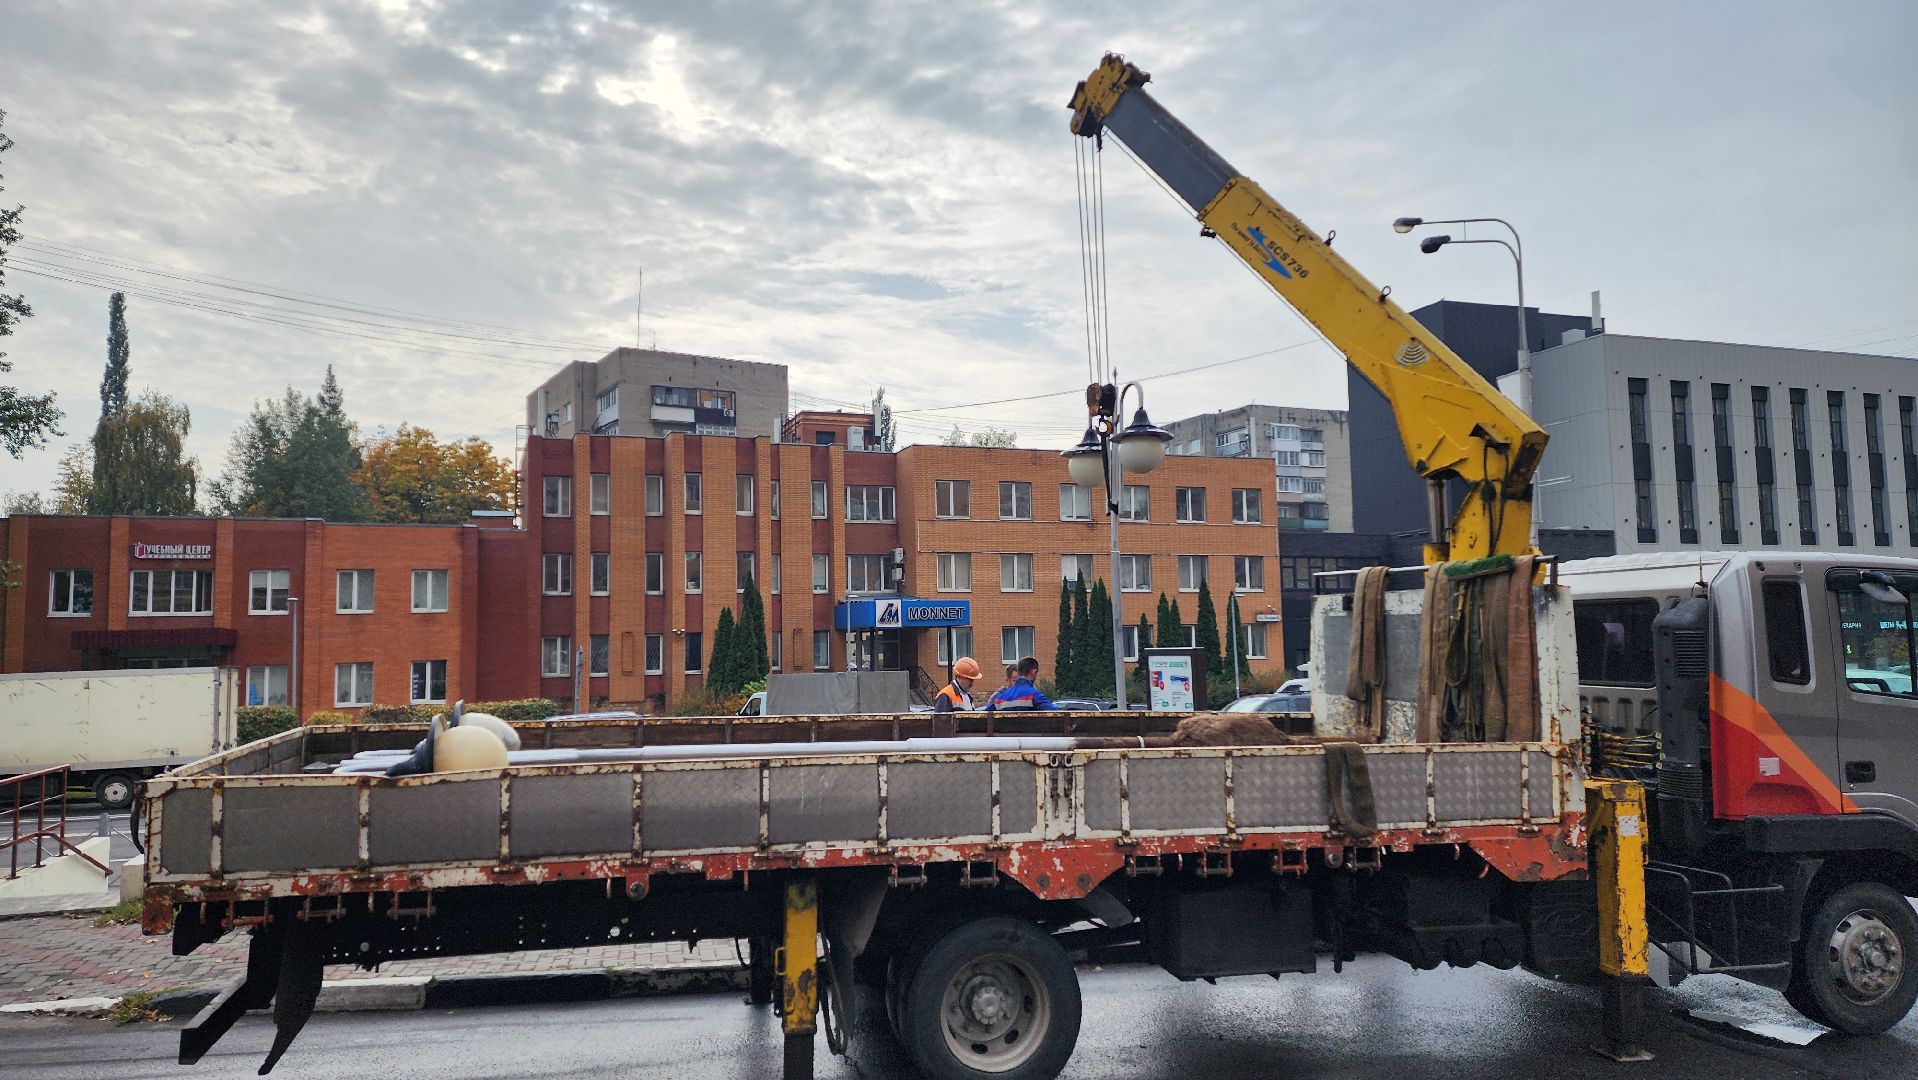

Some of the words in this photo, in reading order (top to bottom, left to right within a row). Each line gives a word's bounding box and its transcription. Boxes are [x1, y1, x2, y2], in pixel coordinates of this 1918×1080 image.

[1268, 240, 1310, 278] SCS736
[146, 544, 184, 554] УЧЕБНЫЙ
[186, 545, 211, 555] ЦЕНТР
[908, 606, 965, 620] MONNET
